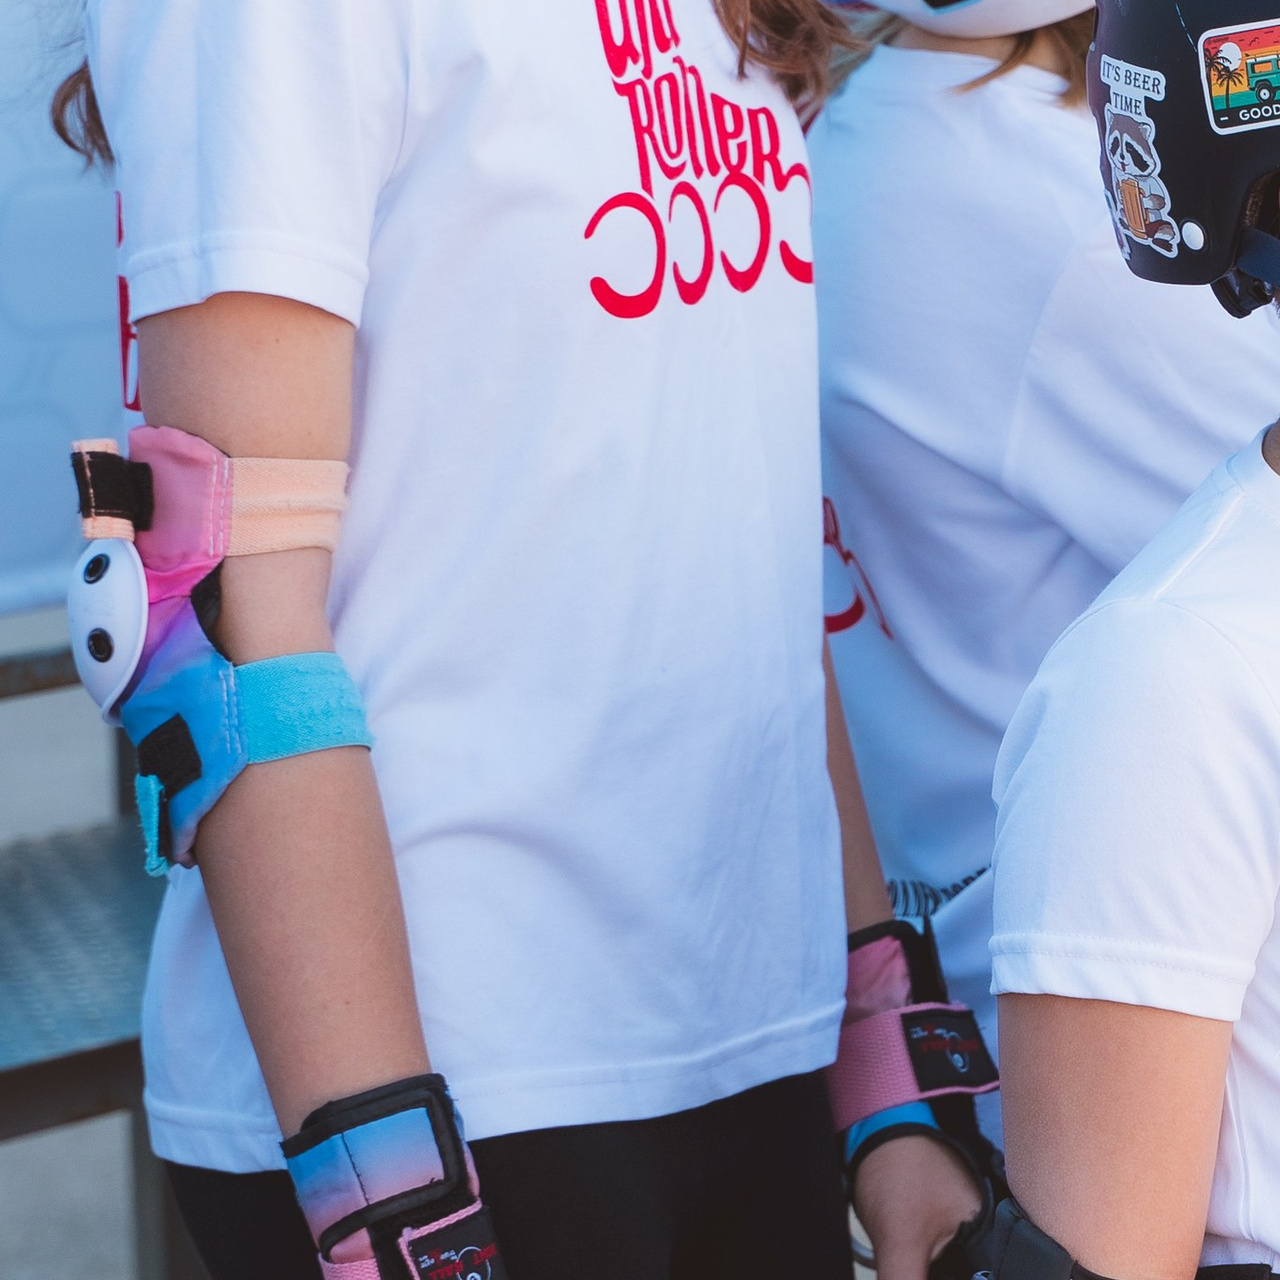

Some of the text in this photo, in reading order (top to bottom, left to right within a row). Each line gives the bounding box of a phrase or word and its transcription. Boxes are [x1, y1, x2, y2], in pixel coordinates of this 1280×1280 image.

[1101, 60, 1162, 96] IT'S BEER
[1112, 91, 1143, 117] TIME
